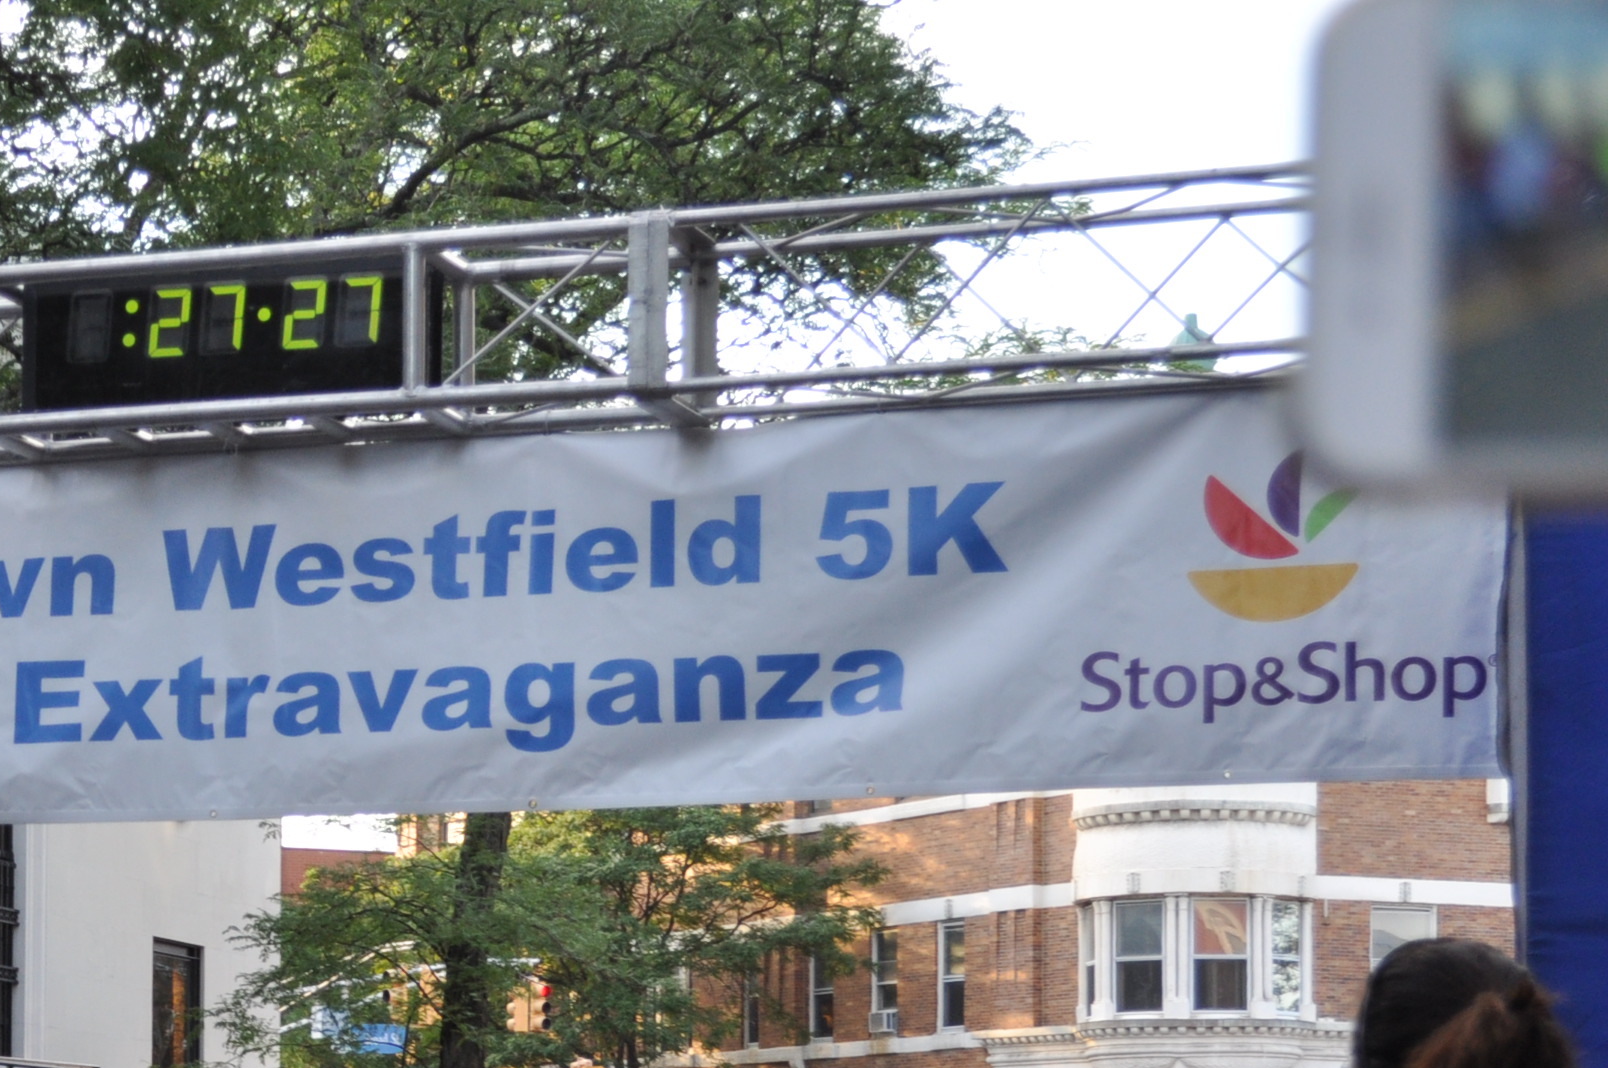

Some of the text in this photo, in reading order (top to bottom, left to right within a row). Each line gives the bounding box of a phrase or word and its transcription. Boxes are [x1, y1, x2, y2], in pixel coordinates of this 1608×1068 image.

[164, 495, 762, 611] Westfield
[817, 481, 1008, 580] 5K
[14, 649, 905, 753] Extravaganza
[1080, 640, 1488, 724] Stop&Shop
